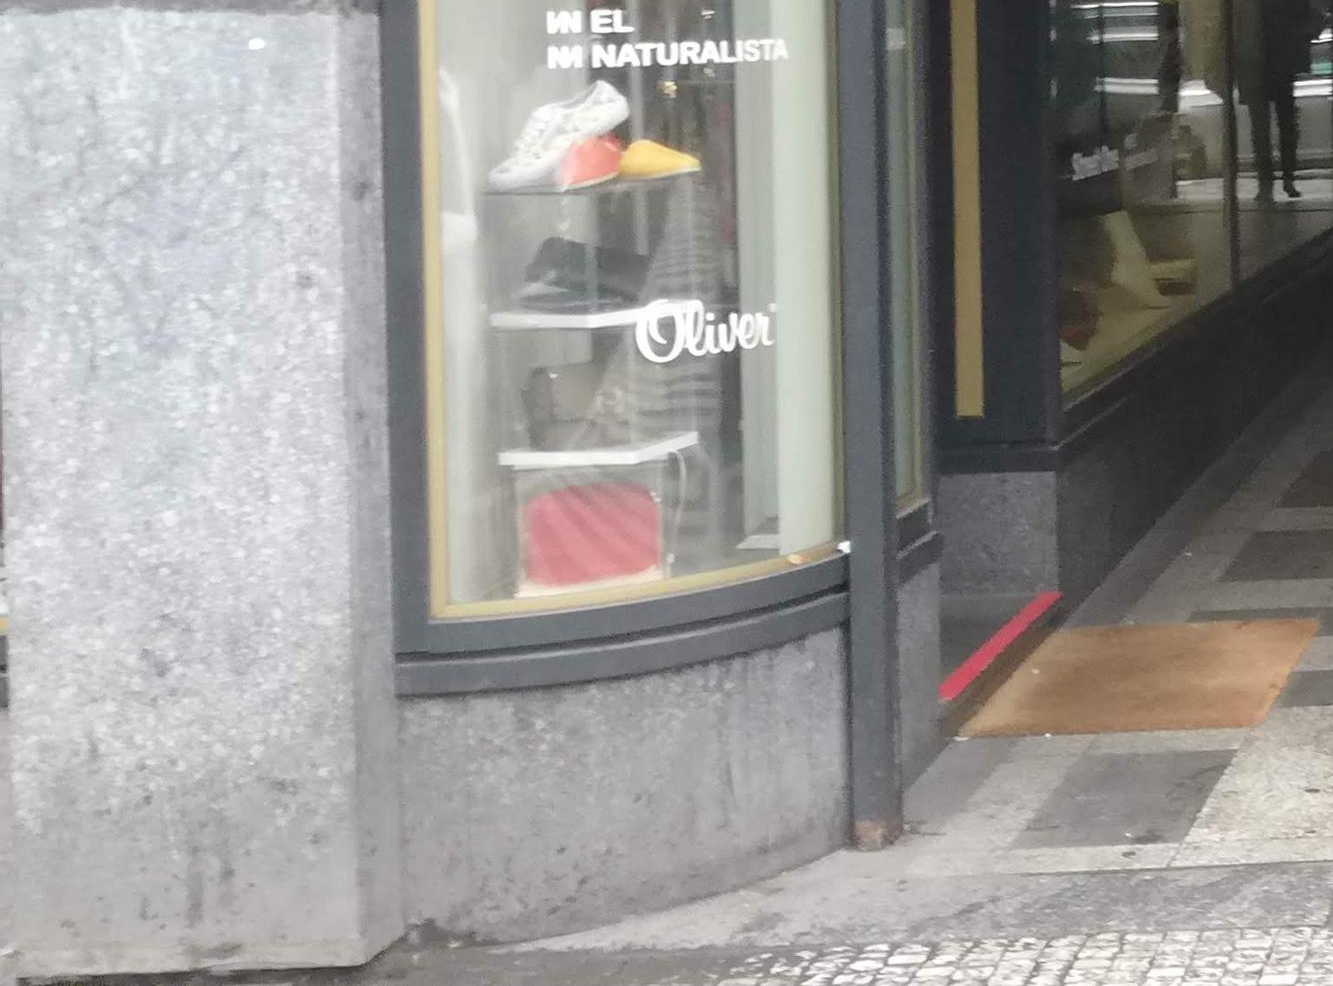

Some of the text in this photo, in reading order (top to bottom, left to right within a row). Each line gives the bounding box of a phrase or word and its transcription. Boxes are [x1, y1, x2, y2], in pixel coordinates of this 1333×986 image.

[590, 9, 635, 34] EL
[591, 39, 789, 69] NATURALISTA
[635, 299, 775, 363] Oliver
